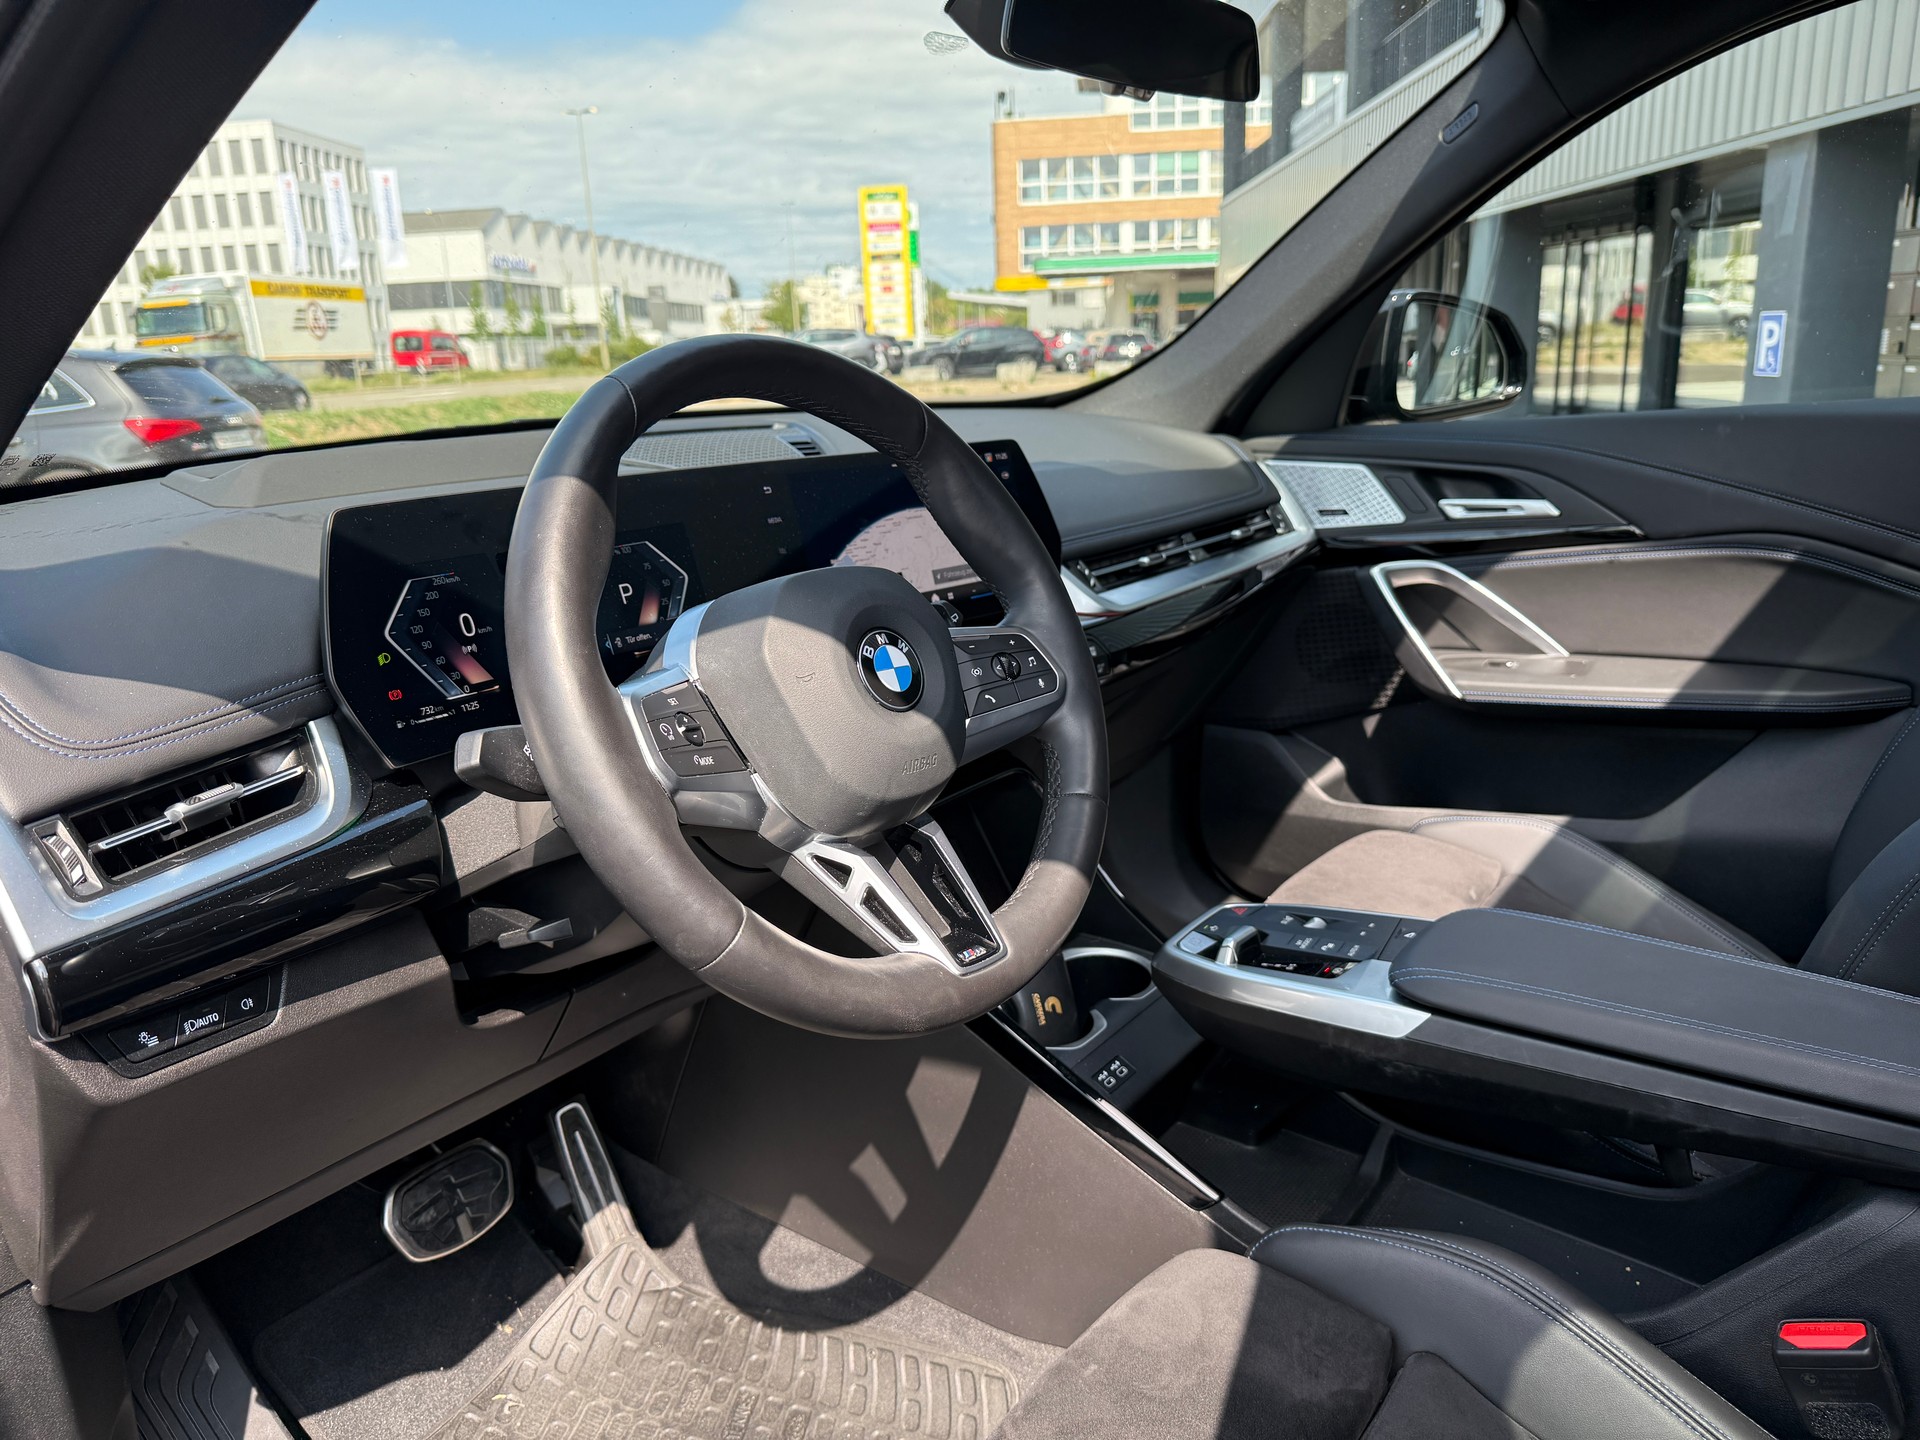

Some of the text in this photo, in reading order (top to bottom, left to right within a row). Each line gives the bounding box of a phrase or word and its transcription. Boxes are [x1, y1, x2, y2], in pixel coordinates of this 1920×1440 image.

[424, 590, 440, 601] 200
[618, 583, 633, 605] P
[417, 608, 431, 617] 150
[410, 625, 424, 634] 120
[459, 612, 476, 637] 0
[421, 640, 433, 650] 90
[862, 633, 909, 660] BMW
[436, 656, 446, 665] 60
[450, 671, 461, 680] 30
[461, 701, 480, 712] 11:25
[667, 697, 680, 706] SET
[901, 753, 938, 776] AIRBAG
